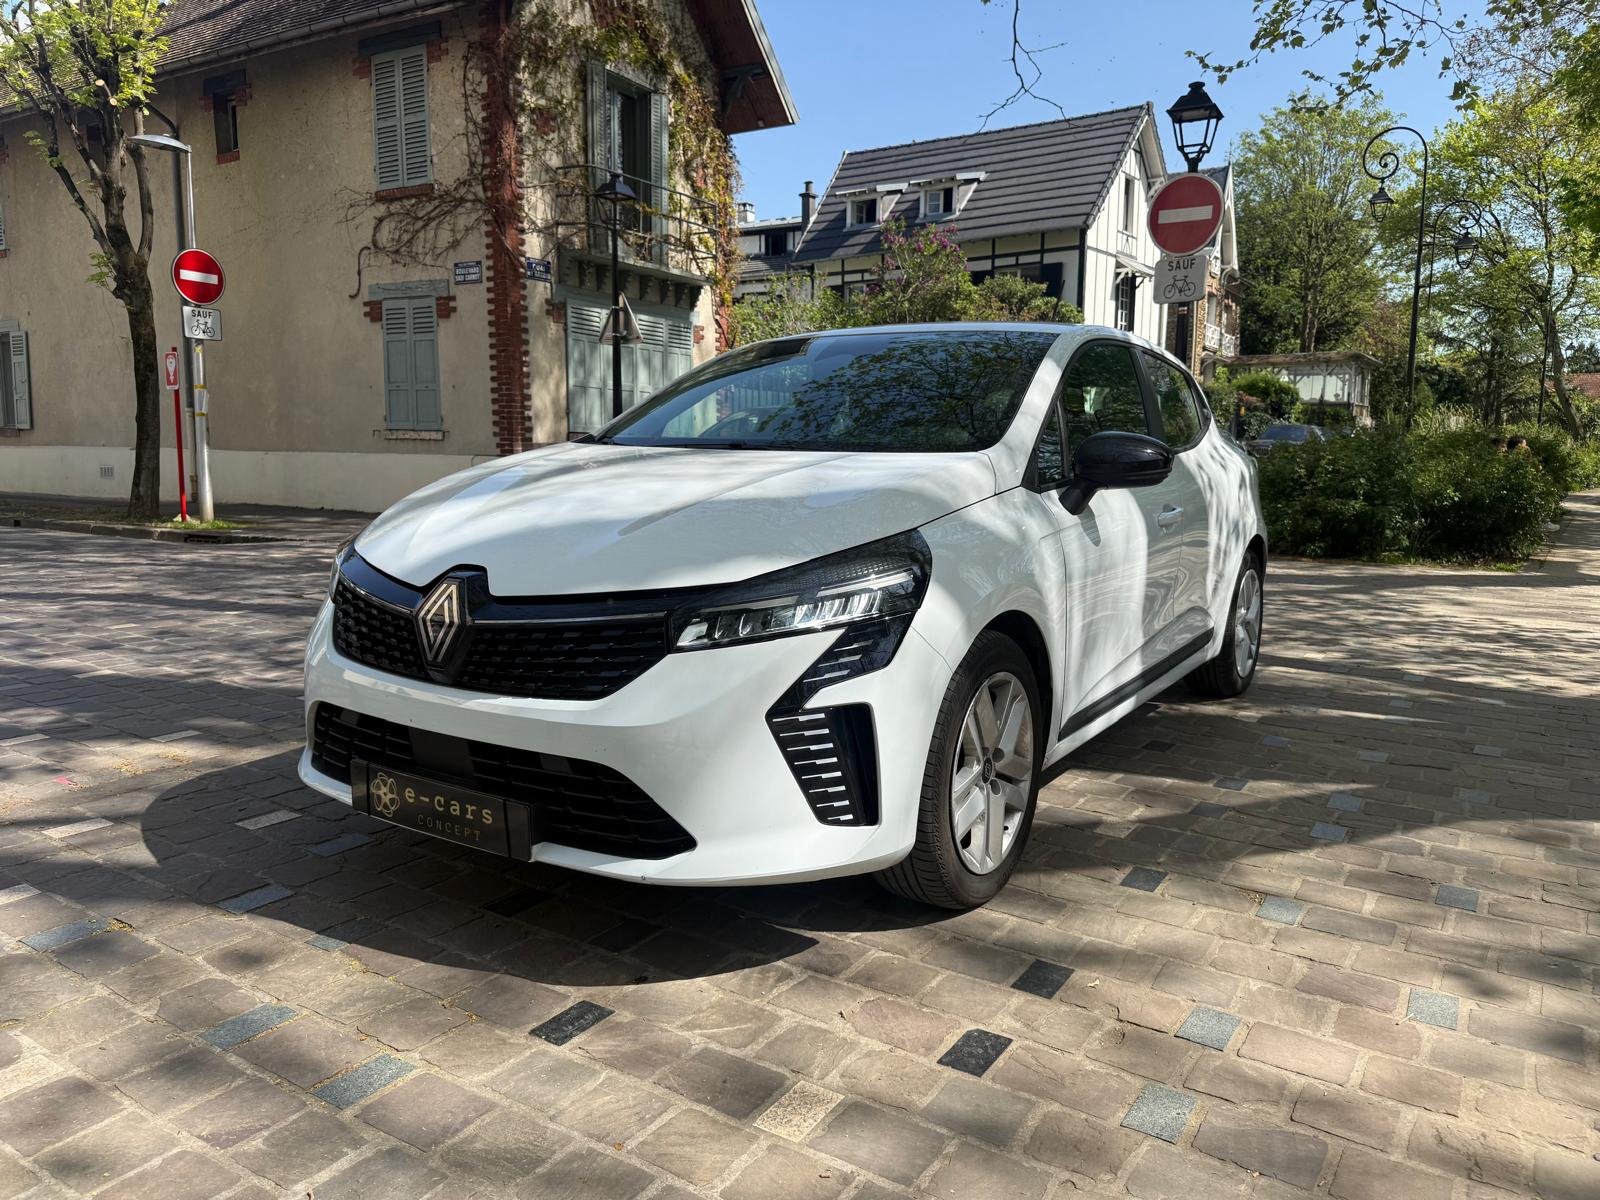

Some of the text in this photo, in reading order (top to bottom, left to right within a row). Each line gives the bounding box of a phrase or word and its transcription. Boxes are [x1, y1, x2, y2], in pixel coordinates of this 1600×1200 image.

[456, 266, 480, 275] BOULEVARD
[1168, 258, 1196, 272] SAUF
[191, 309, 213, 319] SAUF
[404, 787, 494, 825] e-cars
[417, 814, 481, 841] CONCEPT
